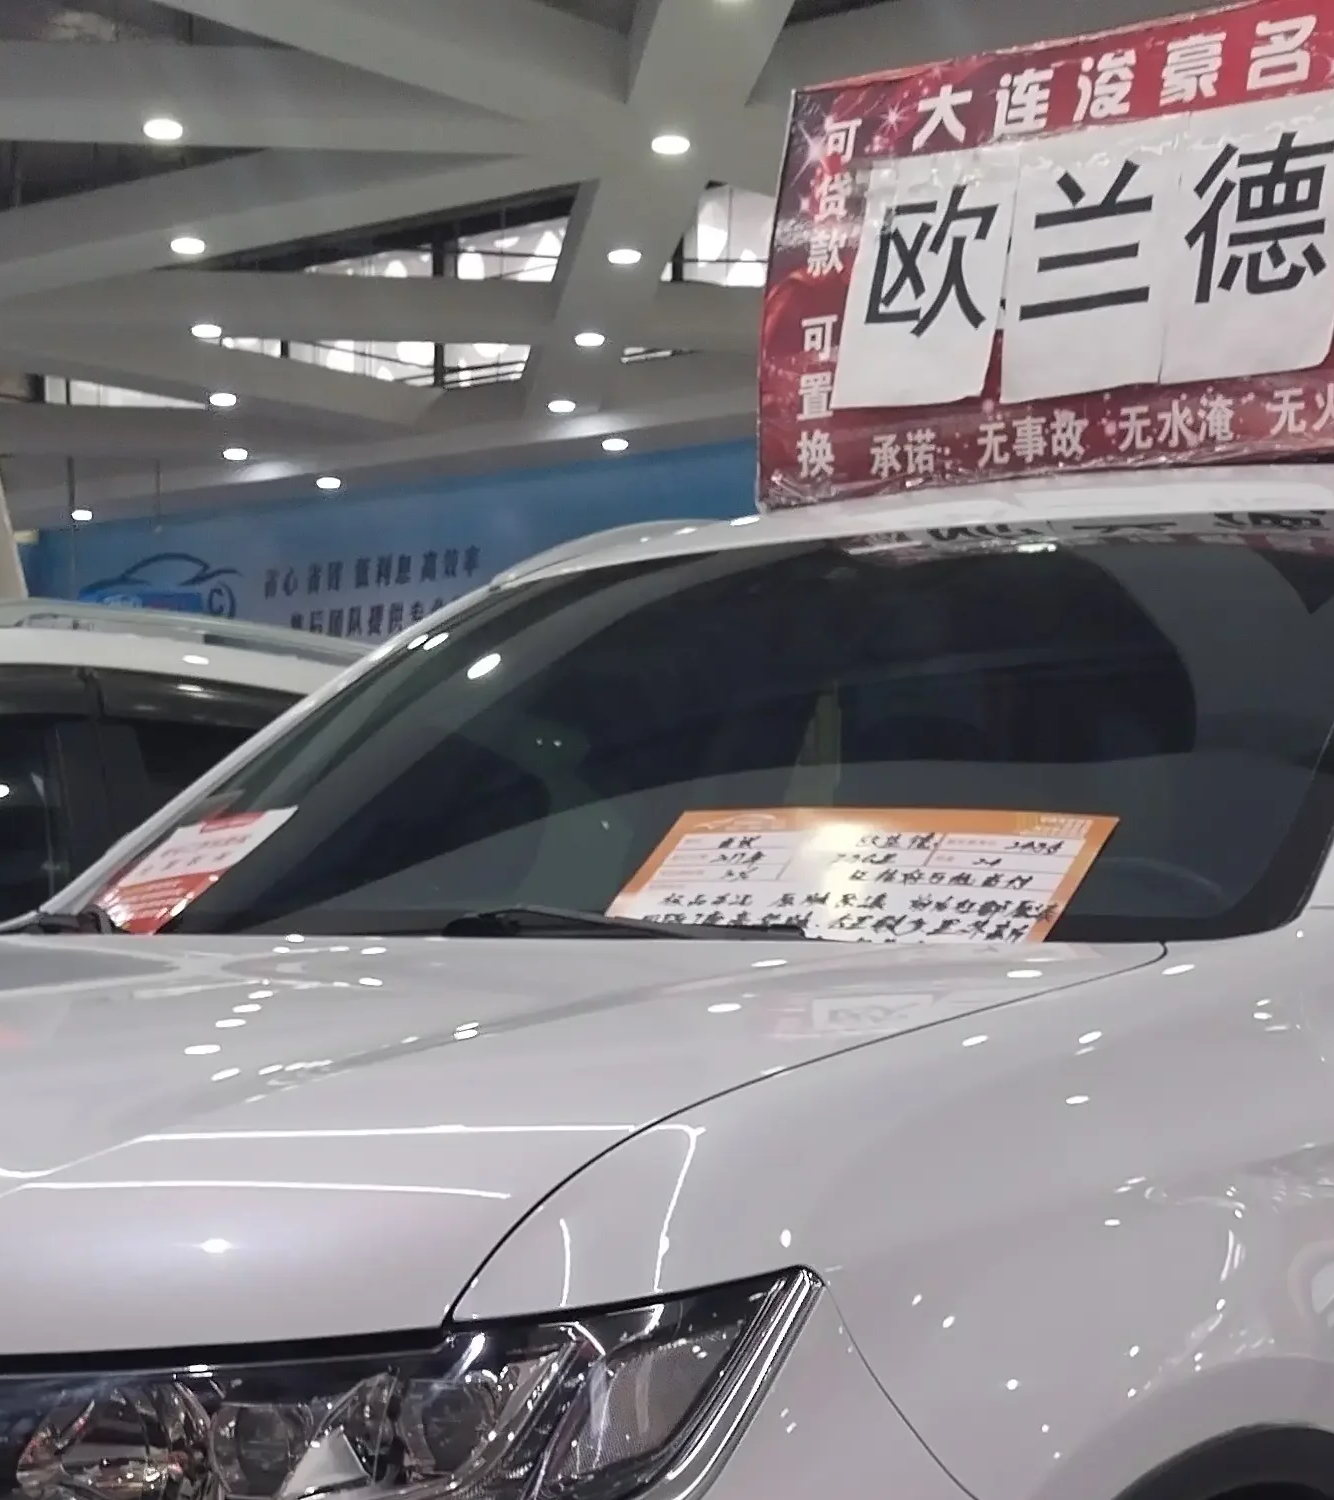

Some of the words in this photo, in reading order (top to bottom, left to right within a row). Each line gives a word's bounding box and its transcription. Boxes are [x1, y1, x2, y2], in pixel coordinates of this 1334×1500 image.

[804, 115, 863, 278] 可贷款
[795, 312, 838, 480] 可置换
[976, 410, 1089, 468] 无事故
[1118, 395, 1237, 452] 无水淹
